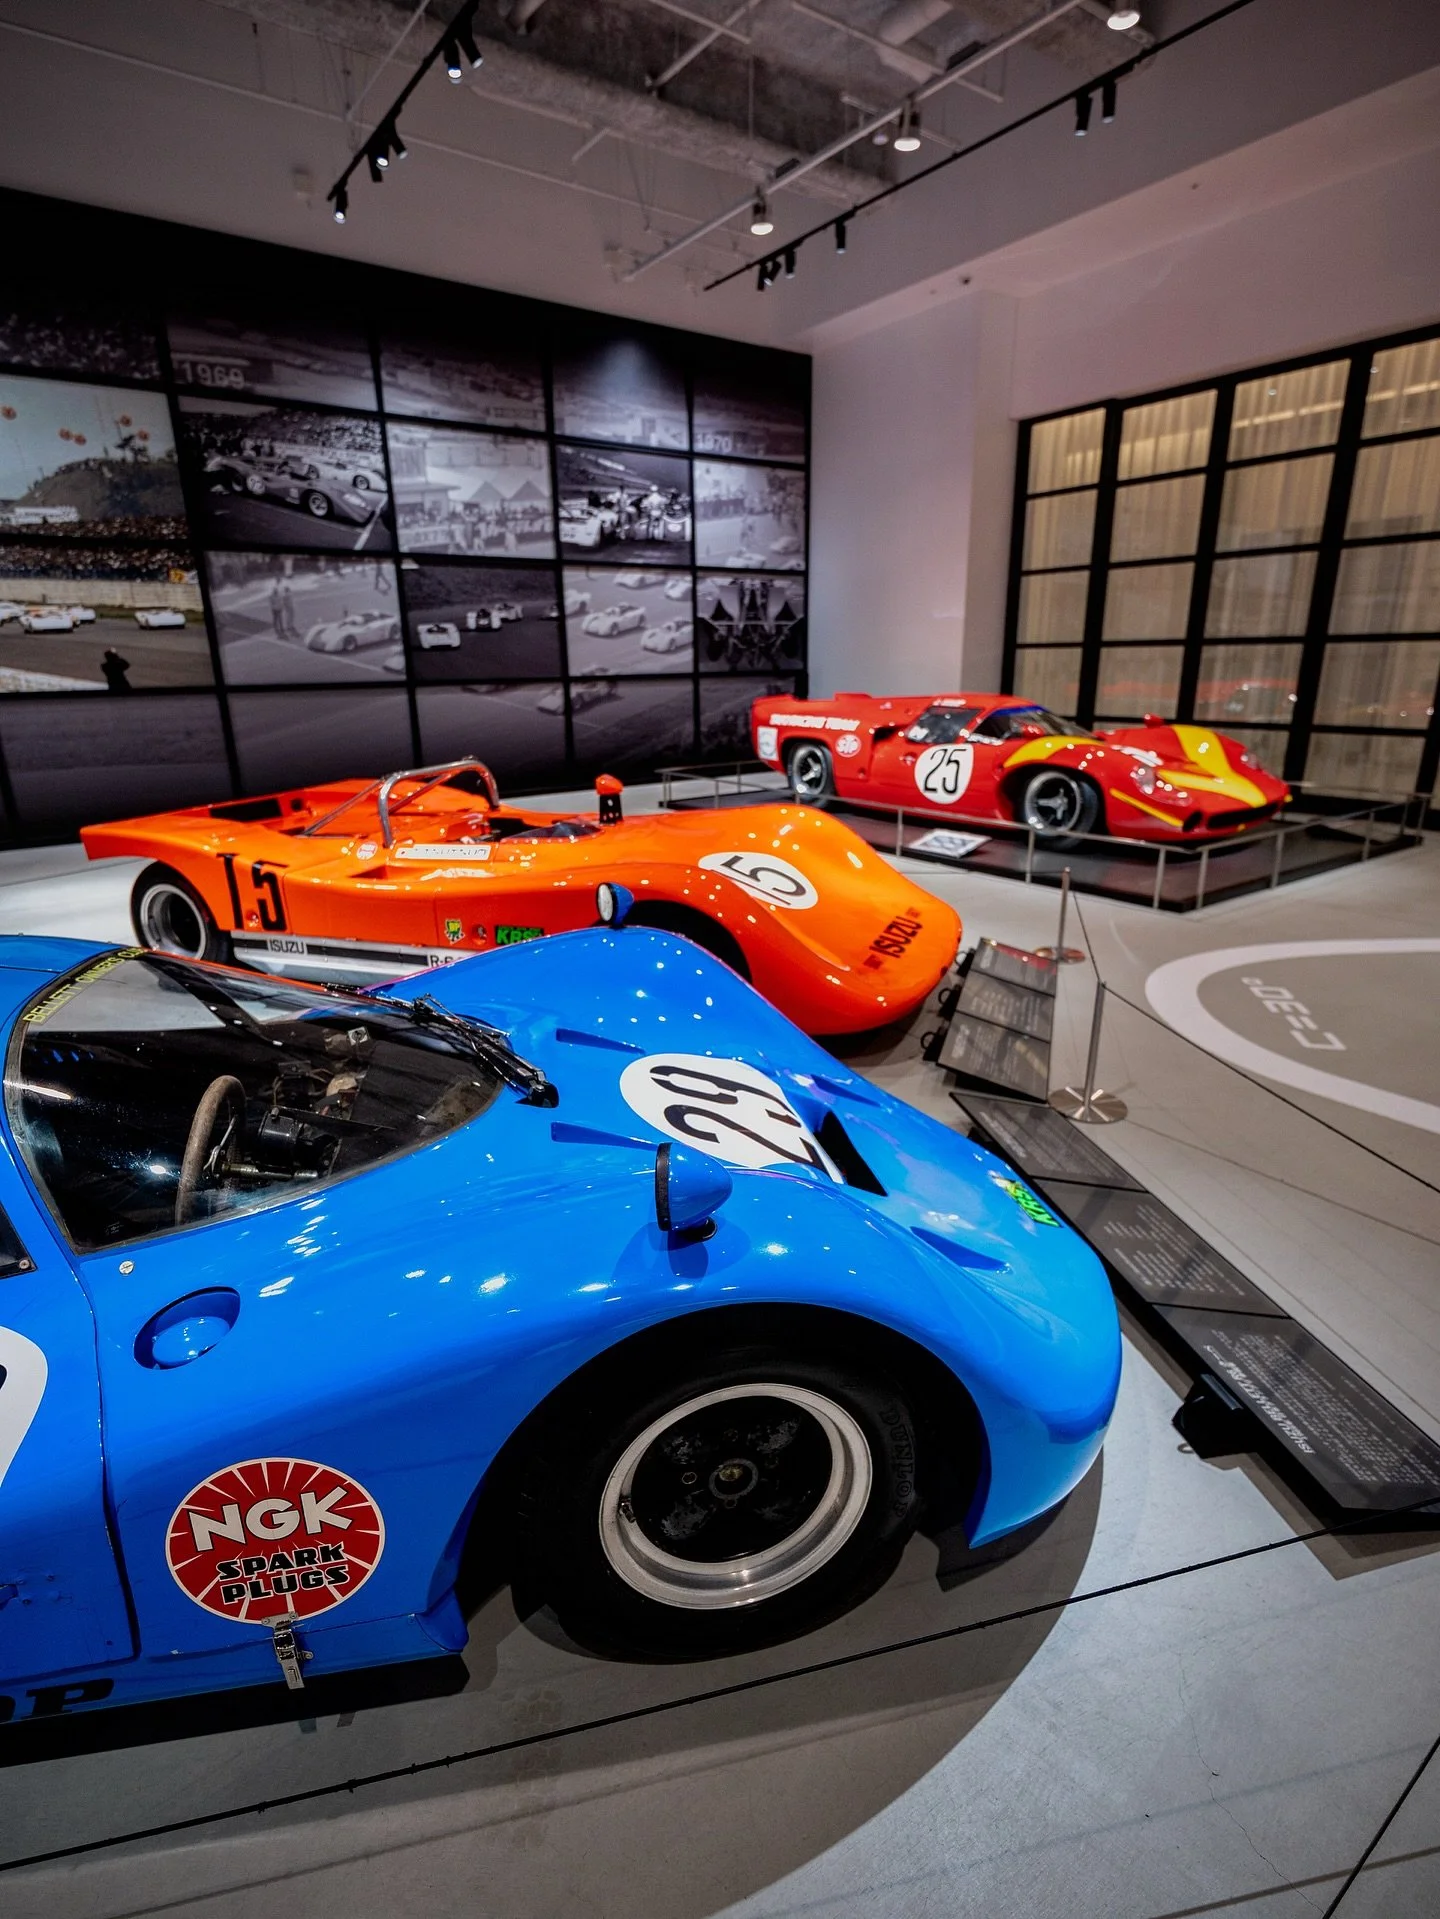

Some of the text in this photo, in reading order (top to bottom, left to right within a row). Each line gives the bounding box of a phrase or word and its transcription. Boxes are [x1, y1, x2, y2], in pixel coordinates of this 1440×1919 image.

[181, 361, 245, 390] 1969
[924, 748, 967, 794] 25
[216, 853, 289, 931] 15
[710, 855, 806, 905] 15
[270, 939, 305, 955] ISUZU
[869, 916, 923, 958] ISUZU
[22, 983, 82, 1022] BELLETT
[649, 1065, 835, 1182] 29
[878, 1407, 914, 1518] DUNLOP
[189, 1485, 353, 1552] NGK
[216, 1541, 348, 1582] SPARK
[220, 1565, 350, 1604] PLUGS
